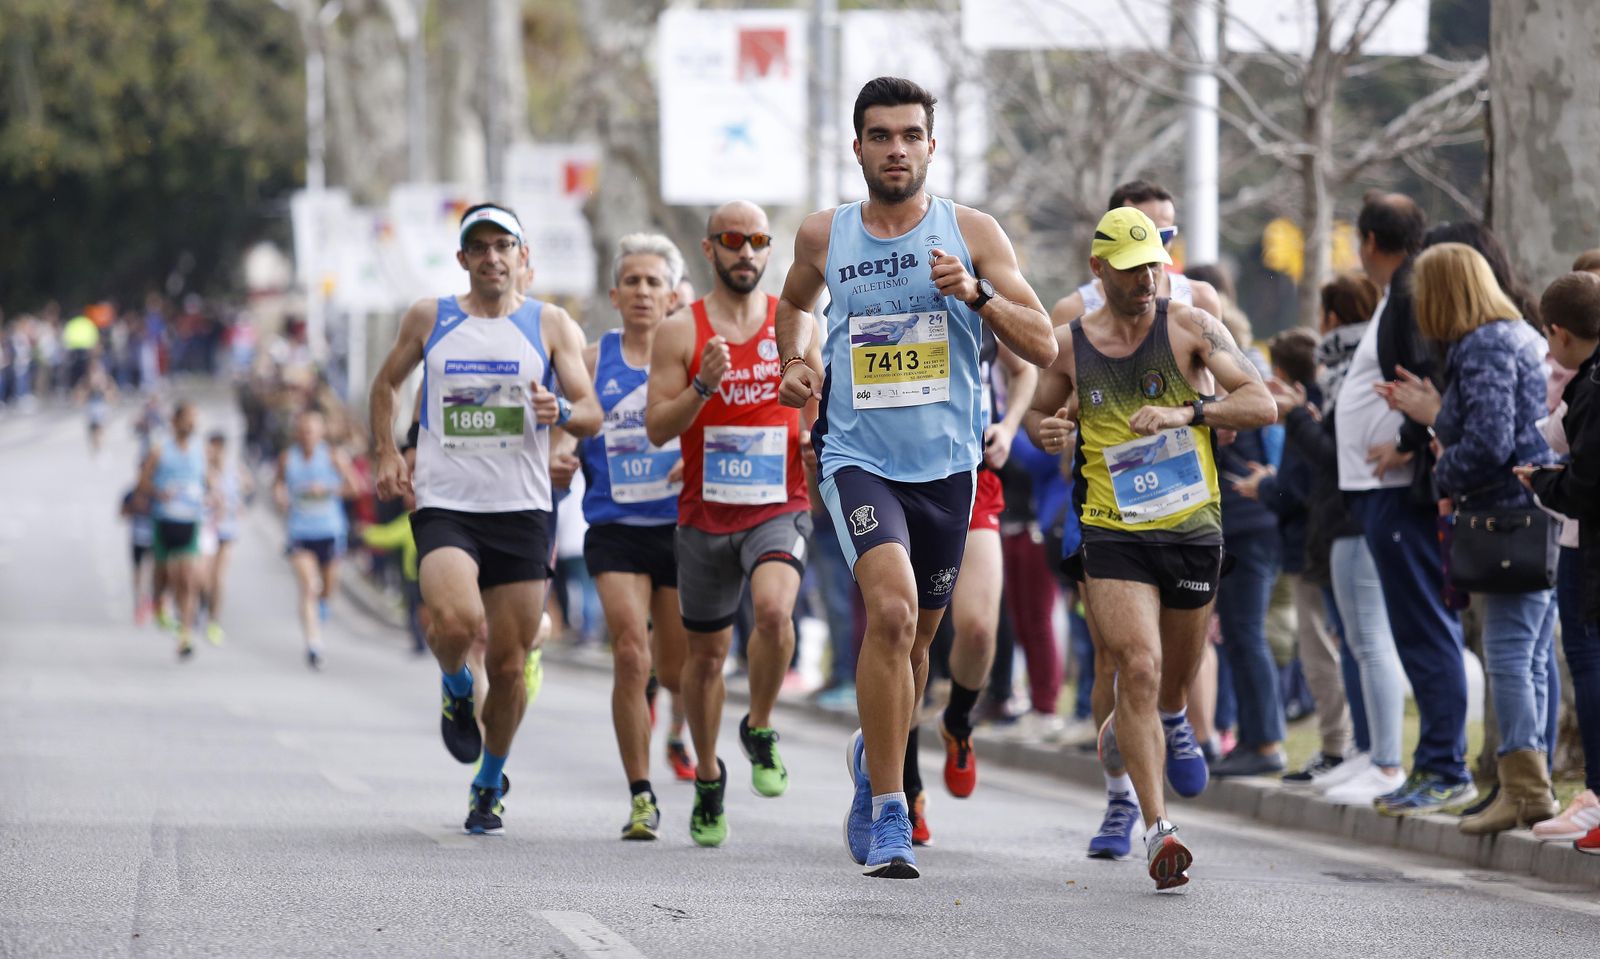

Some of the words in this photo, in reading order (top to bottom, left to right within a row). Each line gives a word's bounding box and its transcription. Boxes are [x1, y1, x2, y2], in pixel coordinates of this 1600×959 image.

[838, 251, 918, 283] nerja
[851, 277, 909, 295] ATLETISMO
[928, 314, 943, 325] 29
[865, 349, 919, 373] 7413
[723, 369, 751, 381] ICAS
[856, 390, 871, 400] edp
[450, 411, 495, 429] 1869
[622, 458, 652, 477] 107
[717, 458, 752, 478] 160
[1133, 471, 1159, 493] 89
[1176, 579, 1210, 591] Joma
